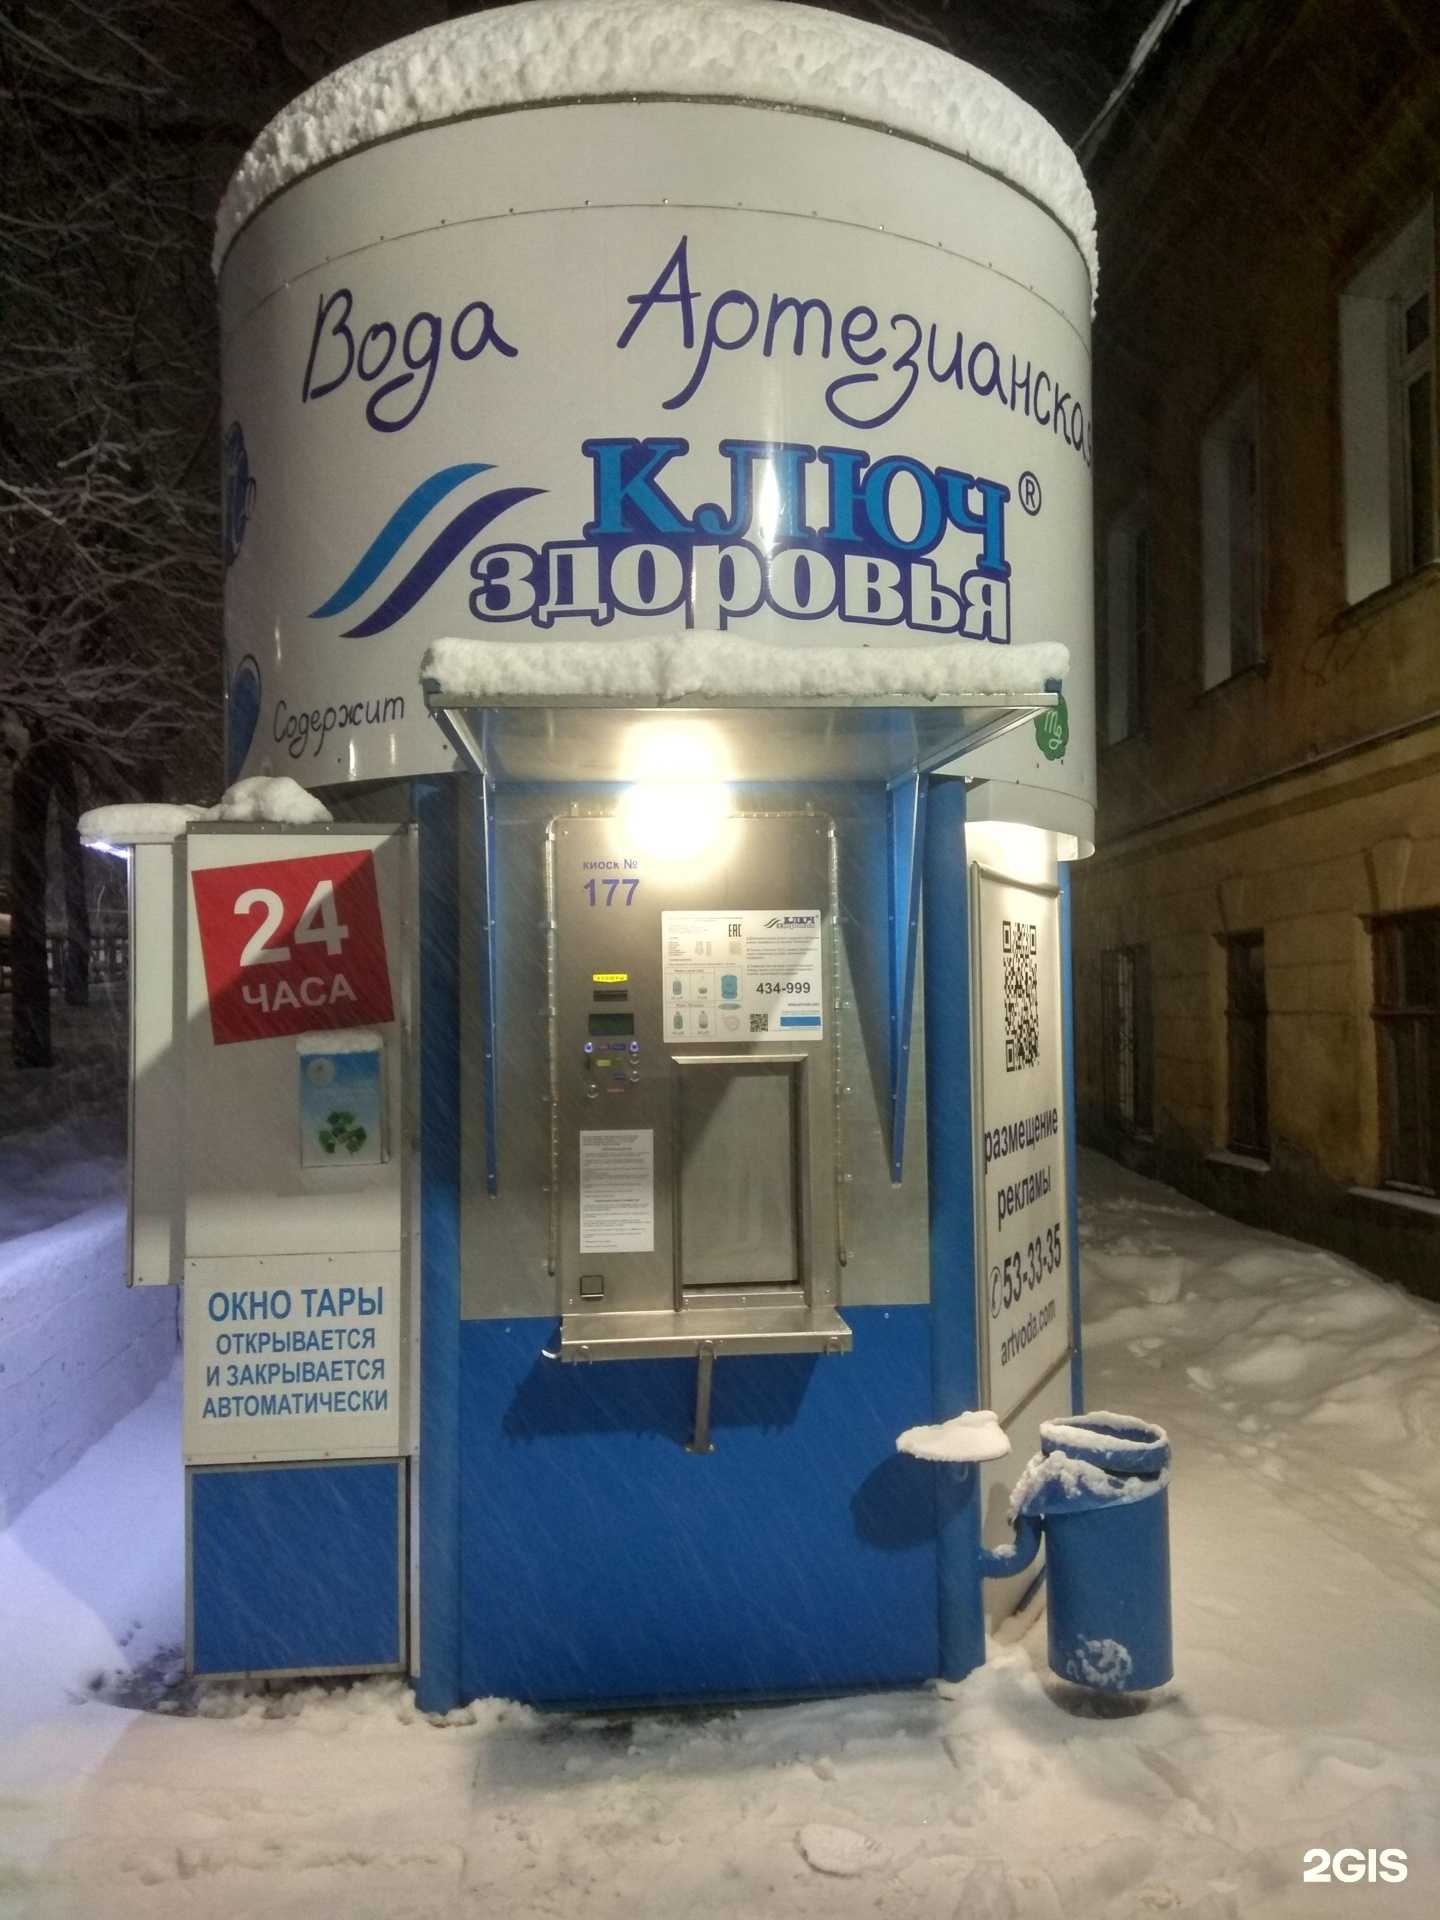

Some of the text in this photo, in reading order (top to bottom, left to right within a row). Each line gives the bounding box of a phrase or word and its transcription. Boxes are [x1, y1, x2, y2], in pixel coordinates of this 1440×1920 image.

[302, 235, 1092, 468] Вода Артезианска
[582, 438, 1011, 571] КЛЮЧ
[272, 695, 406, 759] Содержит
[233, 879, 349, 967] 24
[583, 878, 640, 907] 177
[241, 973, 358, 1013] ЧАСА
[755, 982, 811, 995] 434-999
[984, 1107, 1058, 1175] размещение
[997, 1166, 1052, 1233] рекламы
[1002, 1222, 1062, 1309] 53-33-35
[208, 1286, 383, 1322] ОКНО ТАРЫ
[1000, 1299, 1056, 1366] artvoda.com
[206, 1358, 385, 1387] И ЗАКРЫВАЕТСЯ
[216, 1327, 376, 1355] ОТКРЫВАЕТСЯ
[202, 1389, 388, 1419] АВТОМАТИЧЕСКИ
